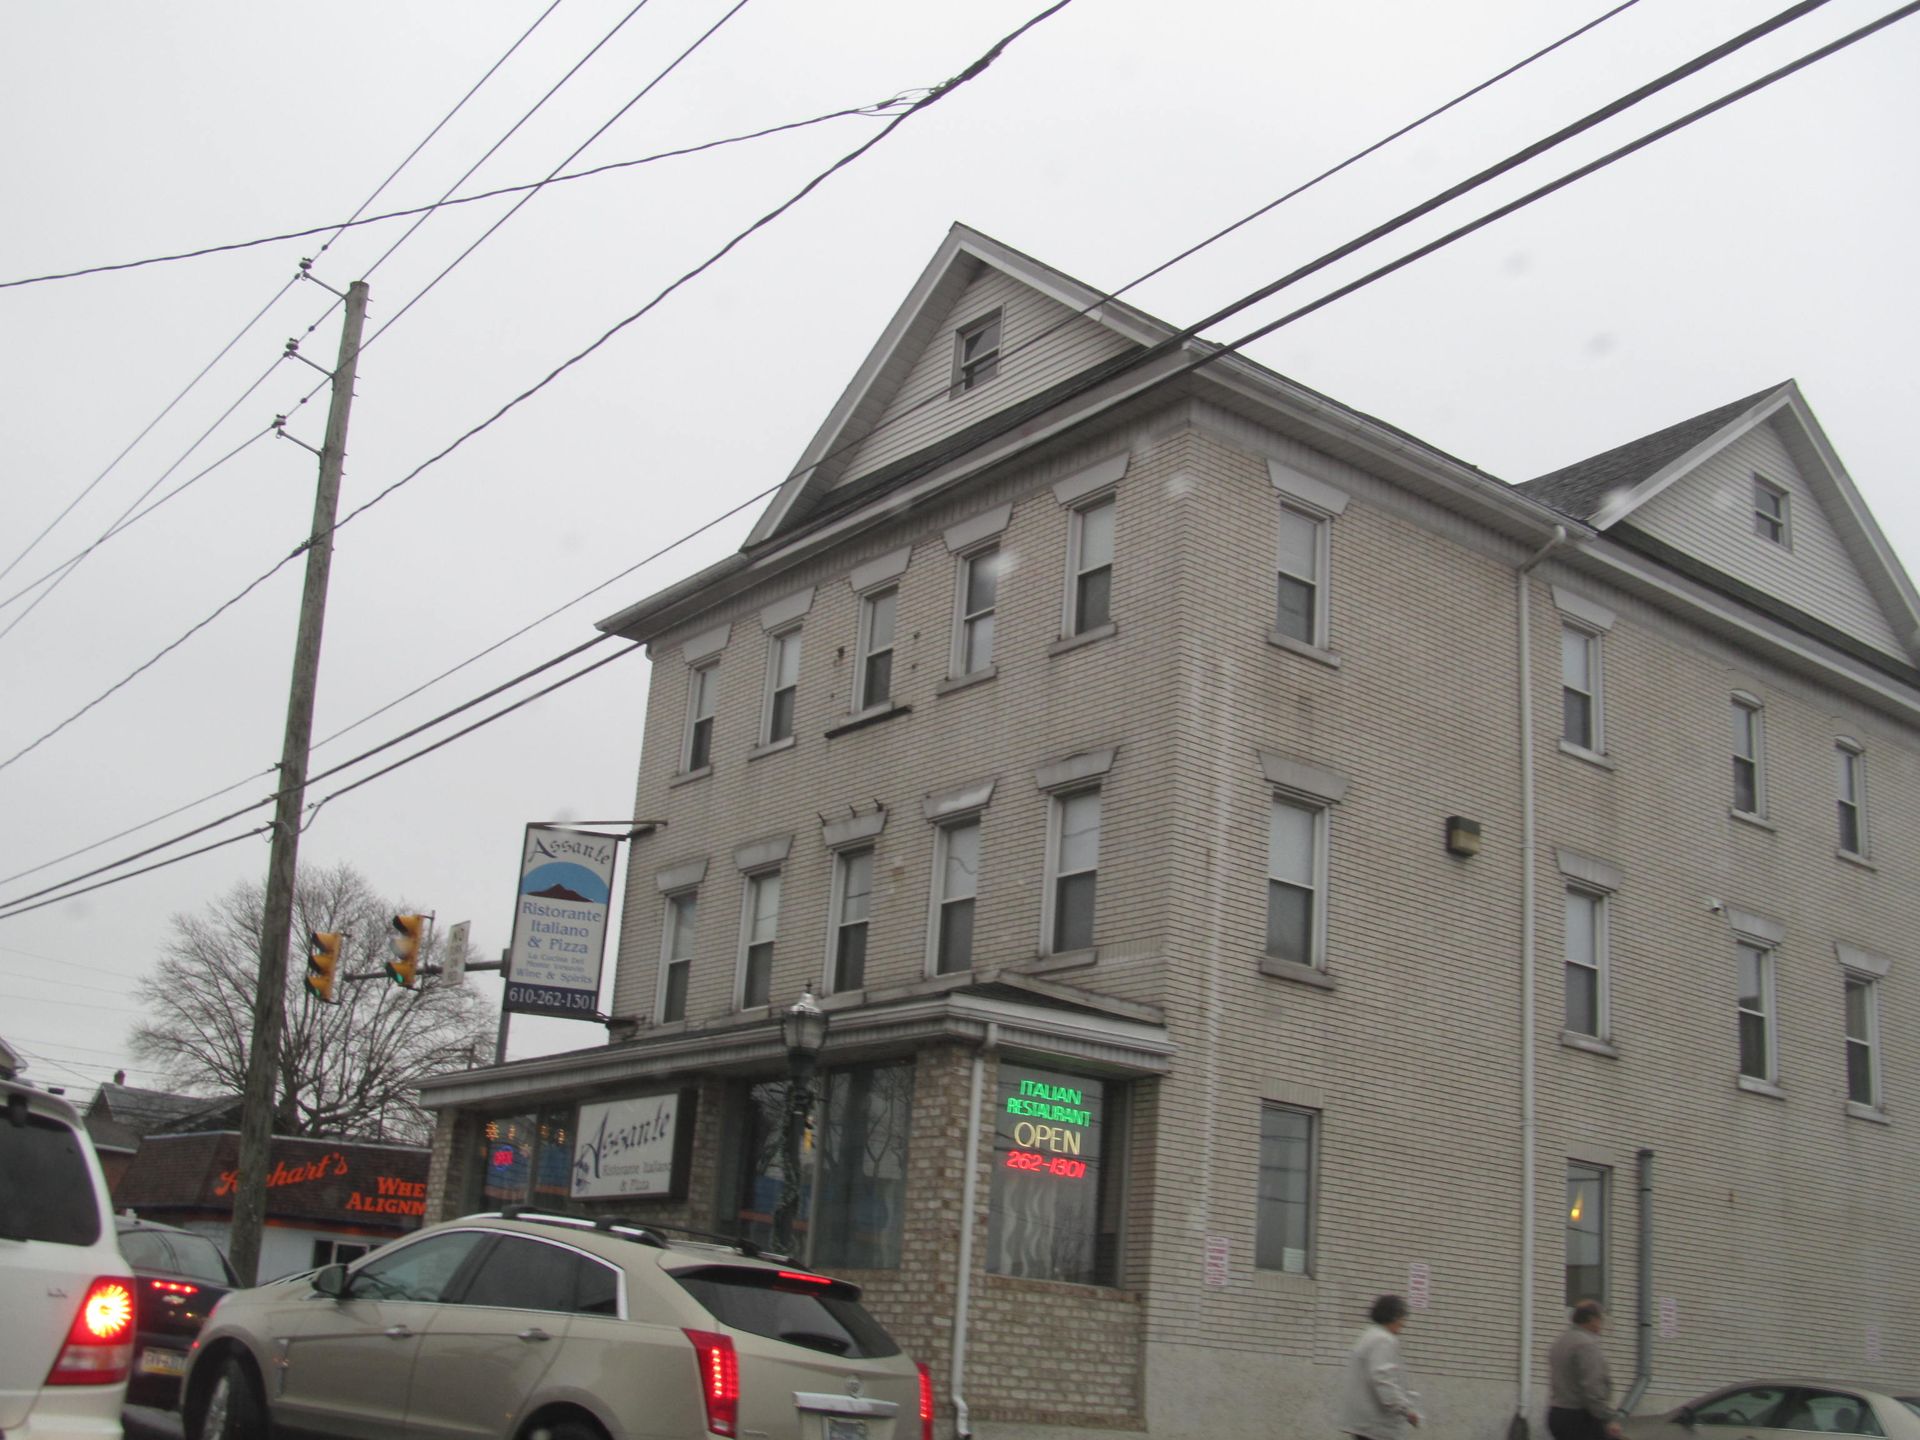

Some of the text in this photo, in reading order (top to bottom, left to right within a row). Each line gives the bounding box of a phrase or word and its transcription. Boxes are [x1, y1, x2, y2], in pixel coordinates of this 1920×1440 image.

[528, 837, 610, 865] Assante
[522, 901, 602, 922] Ristorante
[531, 920, 589, 938] Italiano
[527, 936, 588, 954] & Pizza
[1020, 1079, 1082, 1106] ITALIAN
[1006, 1097, 1092, 1128] RESTAURANT
[574, 1100, 671, 1179] Assante
[1014, 1121, 1080, 1155] OPEN
[376, 1176, 426, 1199] WHE
